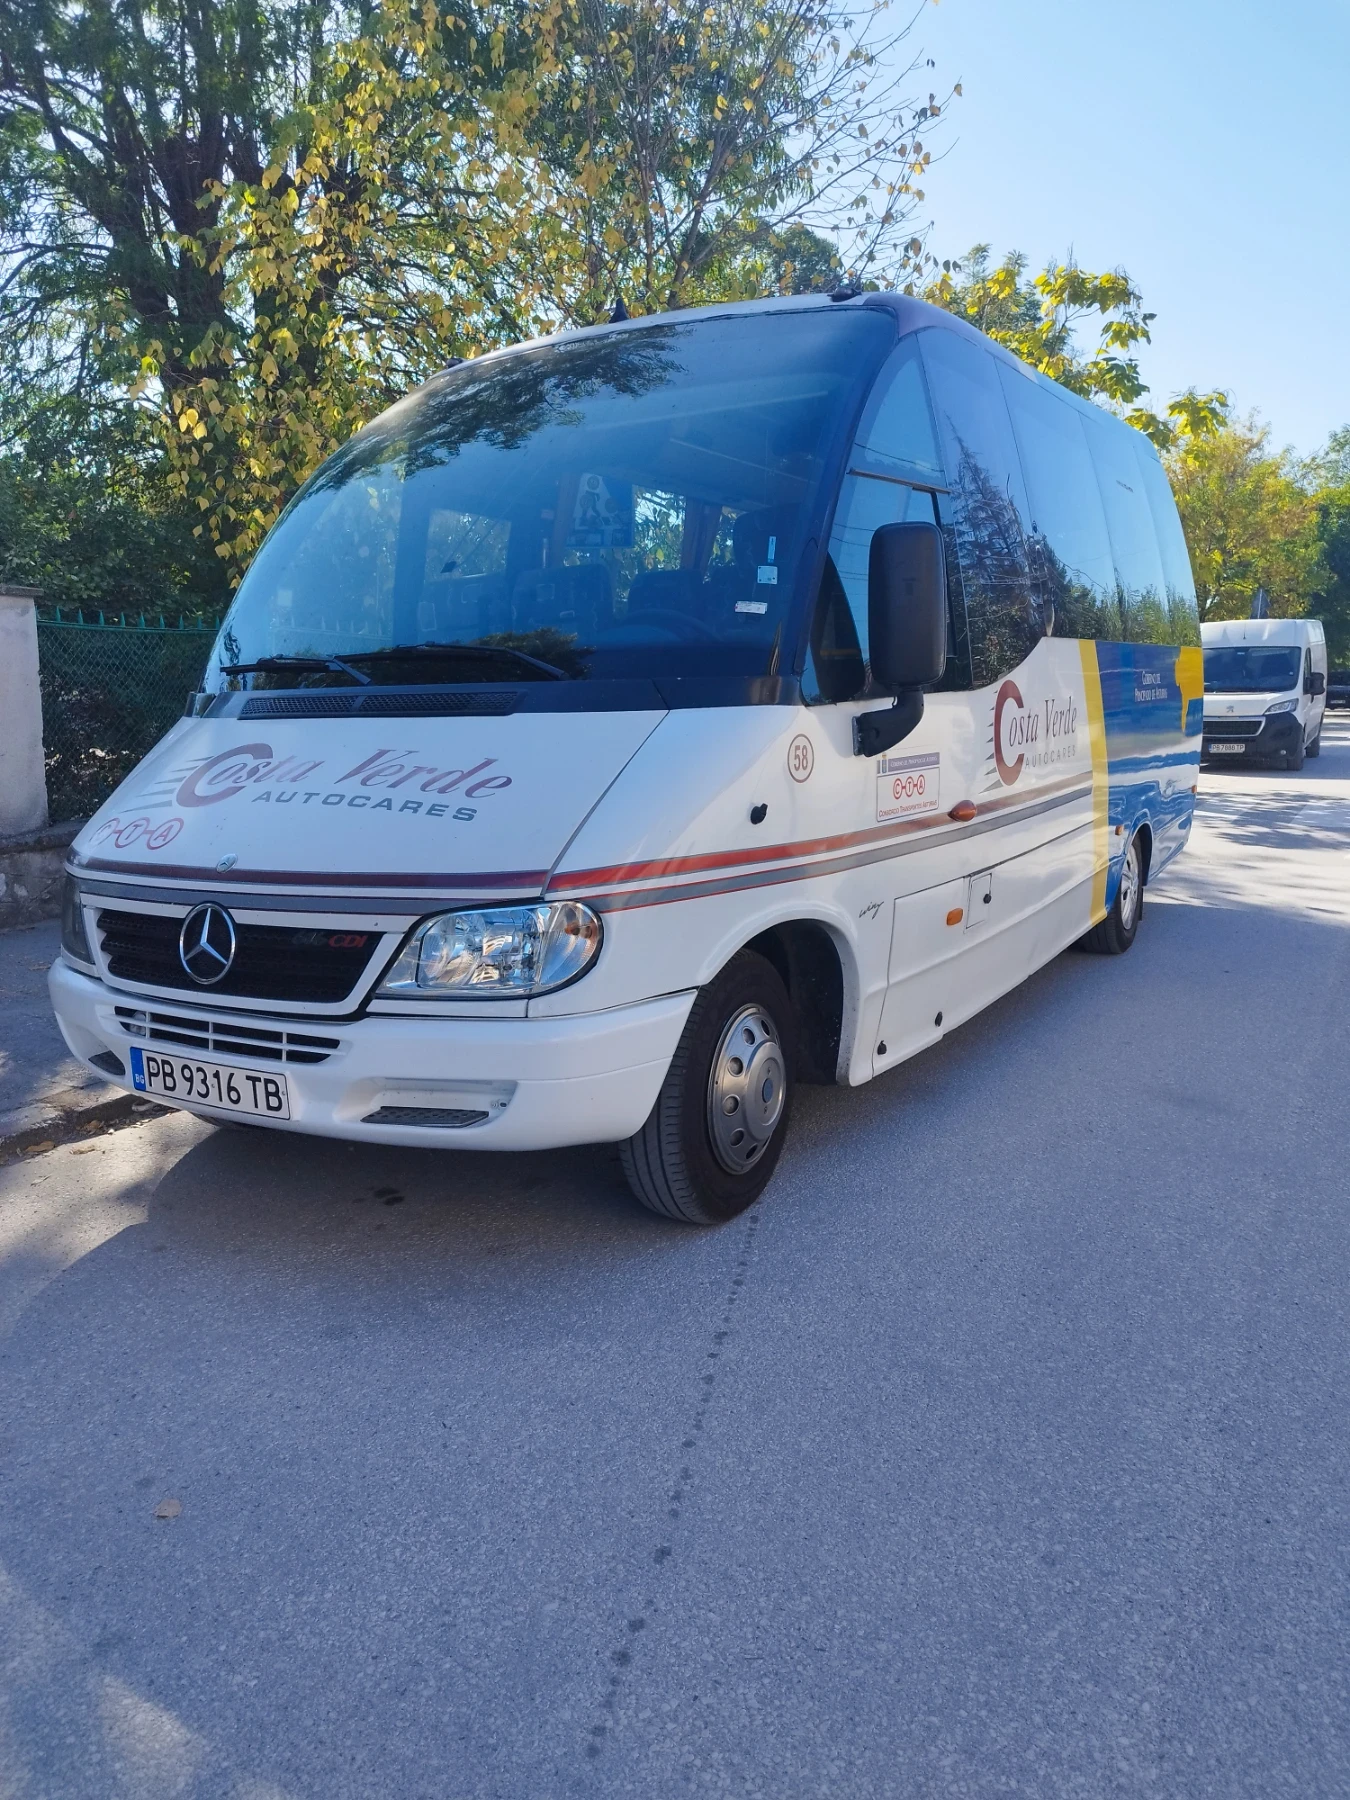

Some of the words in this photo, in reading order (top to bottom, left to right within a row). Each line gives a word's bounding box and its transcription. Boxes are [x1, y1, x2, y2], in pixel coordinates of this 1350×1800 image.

[994, 680, 1039, 786] Costa
[1045, 696, 1077, 739] Verde
[794, 745, 808, 771] 58
[1024, 744, 1076, 770] AUTOCARES
[176, 743, 325, 807] Costa
[334, 749, 513, 798] Verde
[252, 791, 478, 821] AUTOCARES
[135, 1073, 145, 1084] BG
[146, 1056, 177, 1092] PB
[181, 1064, 241, 1104] 9316
[245, 1075, 283, 1112] TB
